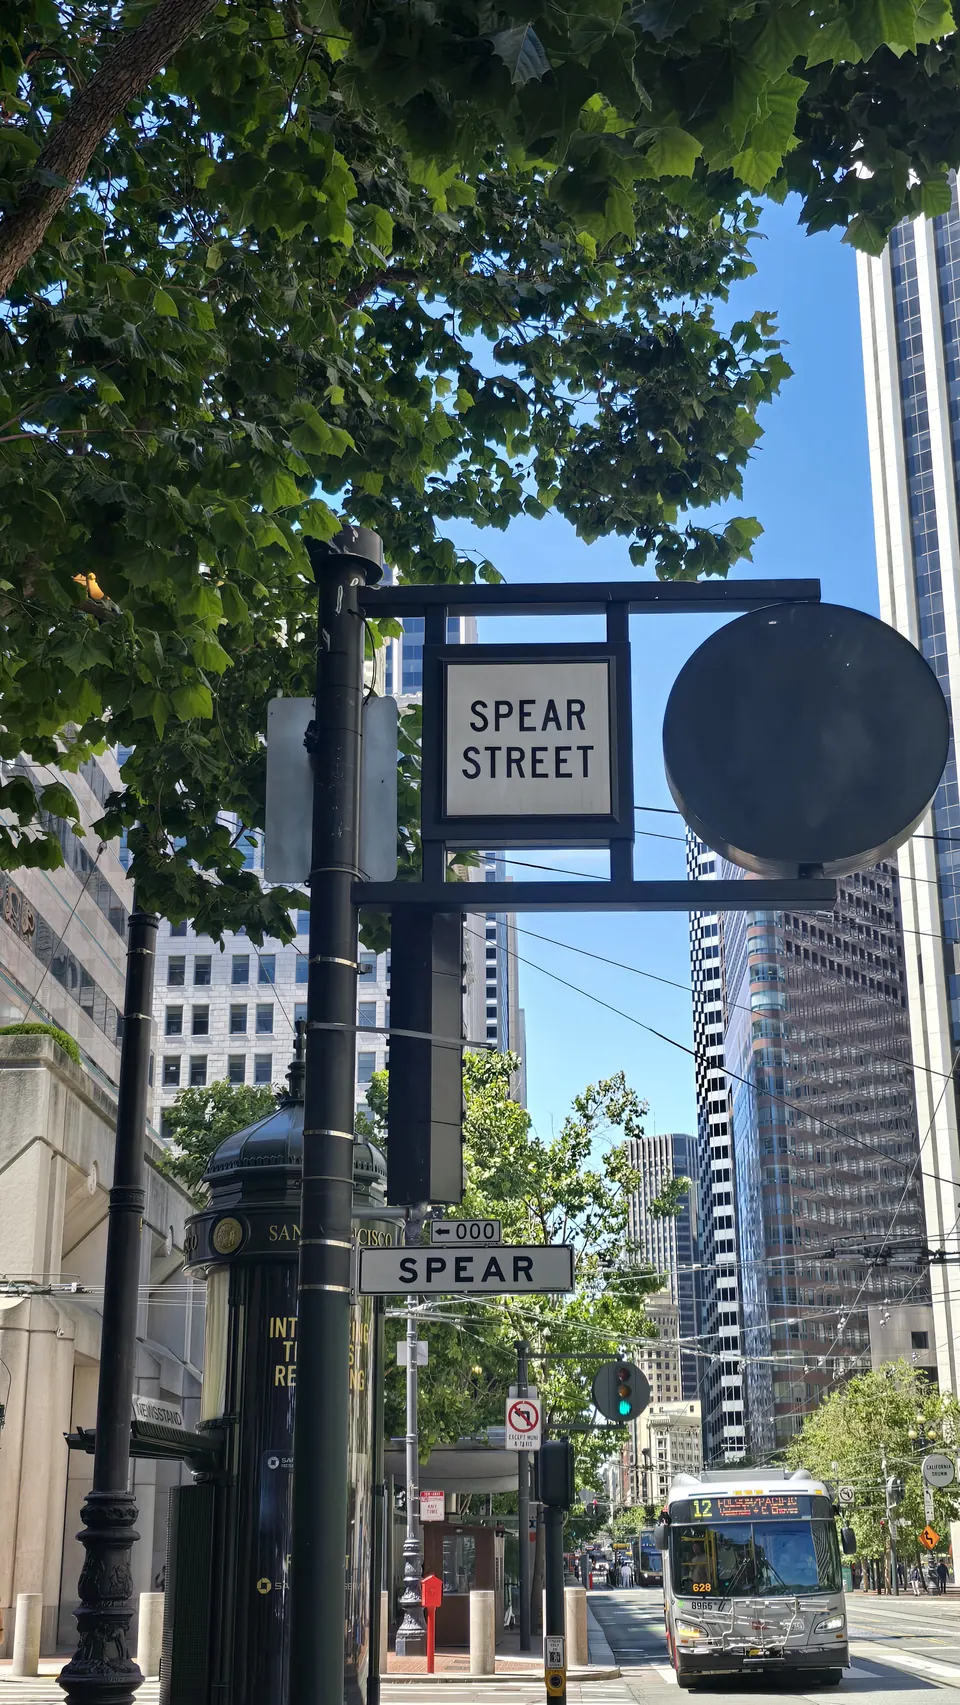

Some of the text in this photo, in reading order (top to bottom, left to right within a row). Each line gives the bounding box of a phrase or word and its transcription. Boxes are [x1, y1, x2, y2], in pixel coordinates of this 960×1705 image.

[470, 699, 586, 733] SPEAR
[462, 745, 594, 779] STREET
[456, 1223, 495, 1240] 000
[398, 1256, 534, 1284] SPEAR
[136, 1402, 182, 1425] NEWSSTAND
[693, 1499, 712, 1517] 12
[692, 1583, 711, 1592] 628
[691, 1602, 713, 1610] 8965
